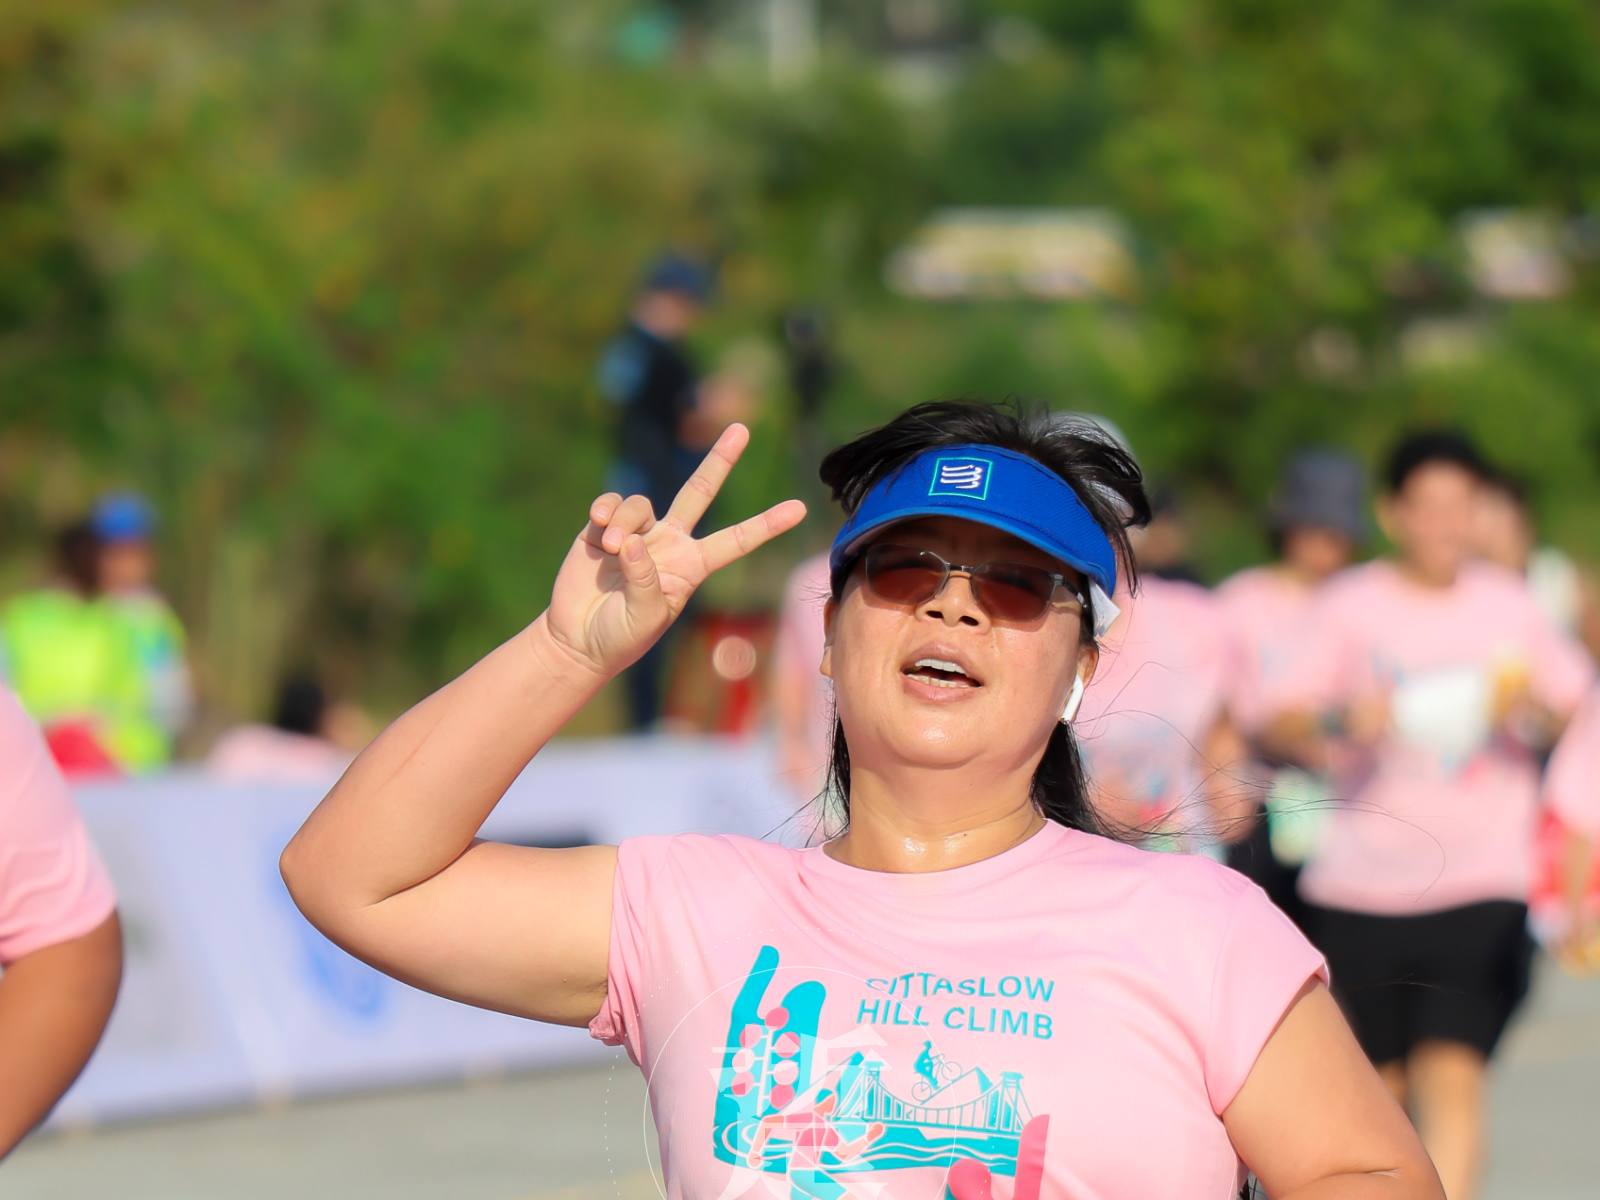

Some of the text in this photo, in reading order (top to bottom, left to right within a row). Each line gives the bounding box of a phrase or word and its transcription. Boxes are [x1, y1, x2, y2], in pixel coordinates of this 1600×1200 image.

[865, 972, 1055, 1003] CITTASLOW
[856, 998, 1054, 1040] HILL CLIMB
